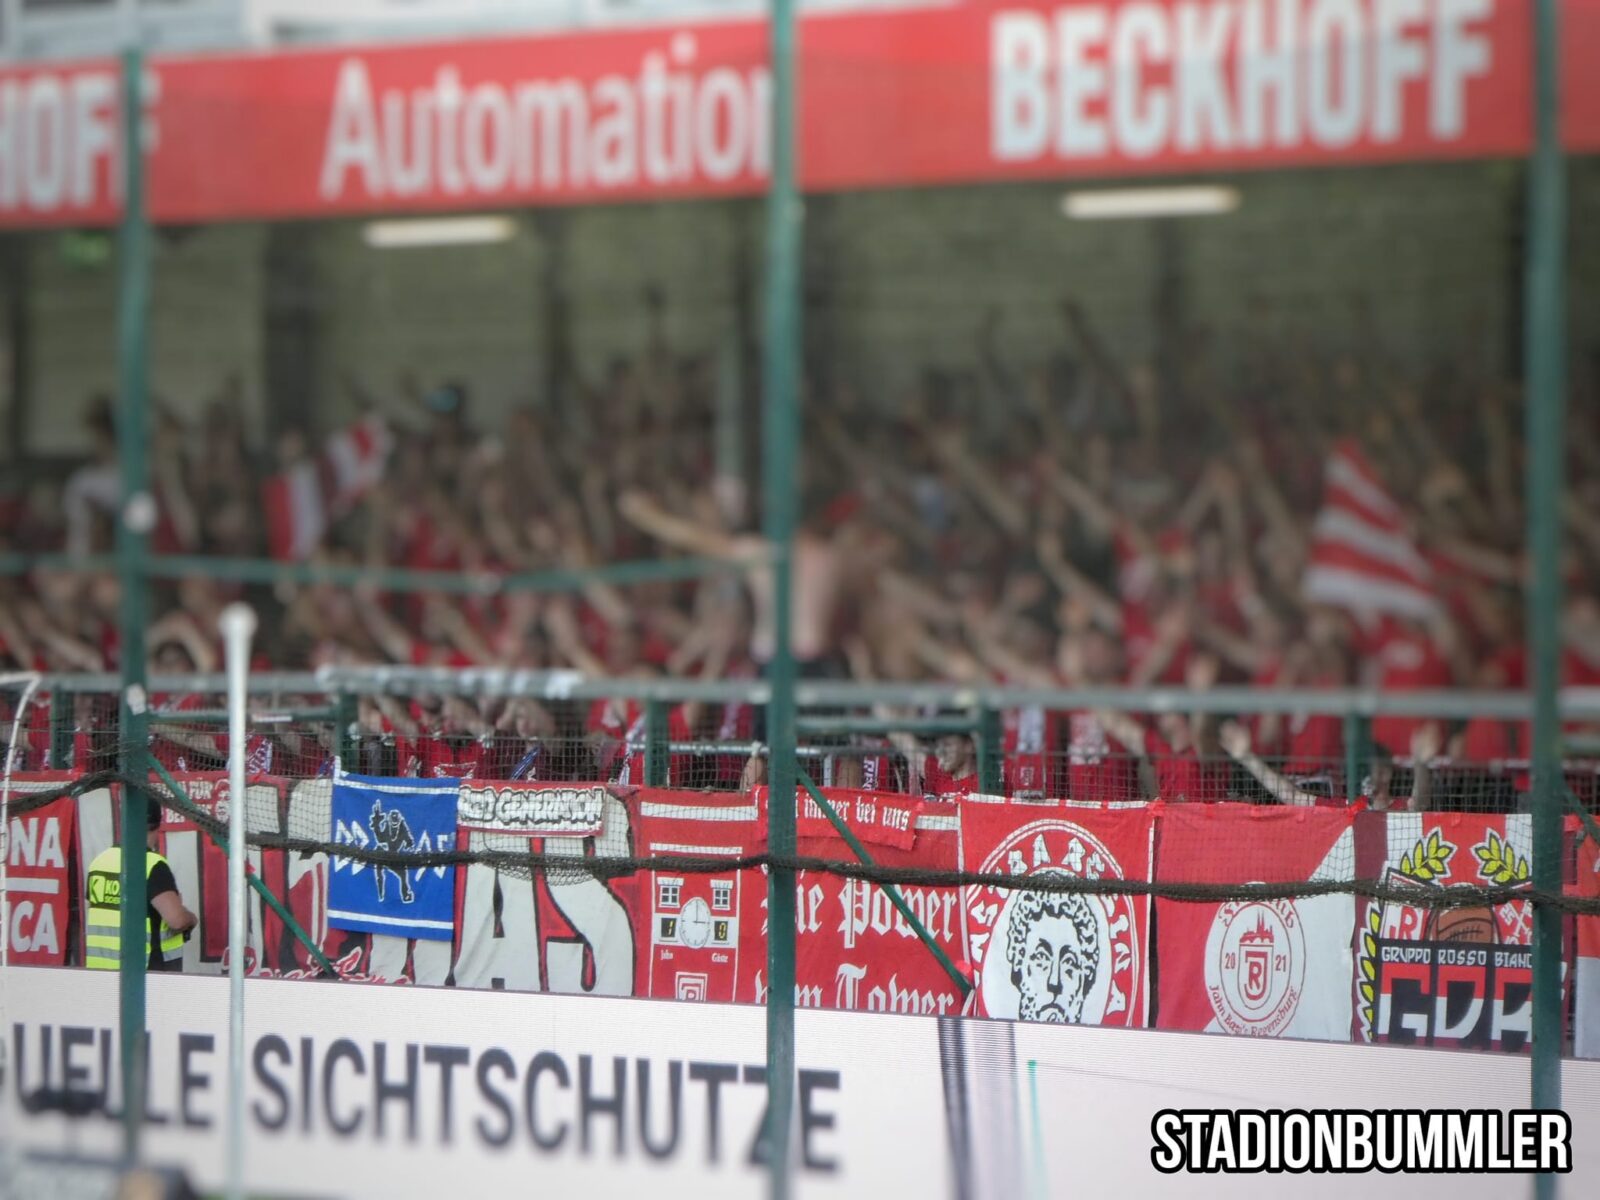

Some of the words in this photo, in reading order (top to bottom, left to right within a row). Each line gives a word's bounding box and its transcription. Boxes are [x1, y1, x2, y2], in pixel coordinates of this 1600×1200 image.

[990, 0, 1492, 161] BECKHOFF
[1437, 949, 1487, 966] ROSSO
[0, 1021, 215, 1130] UELLE
